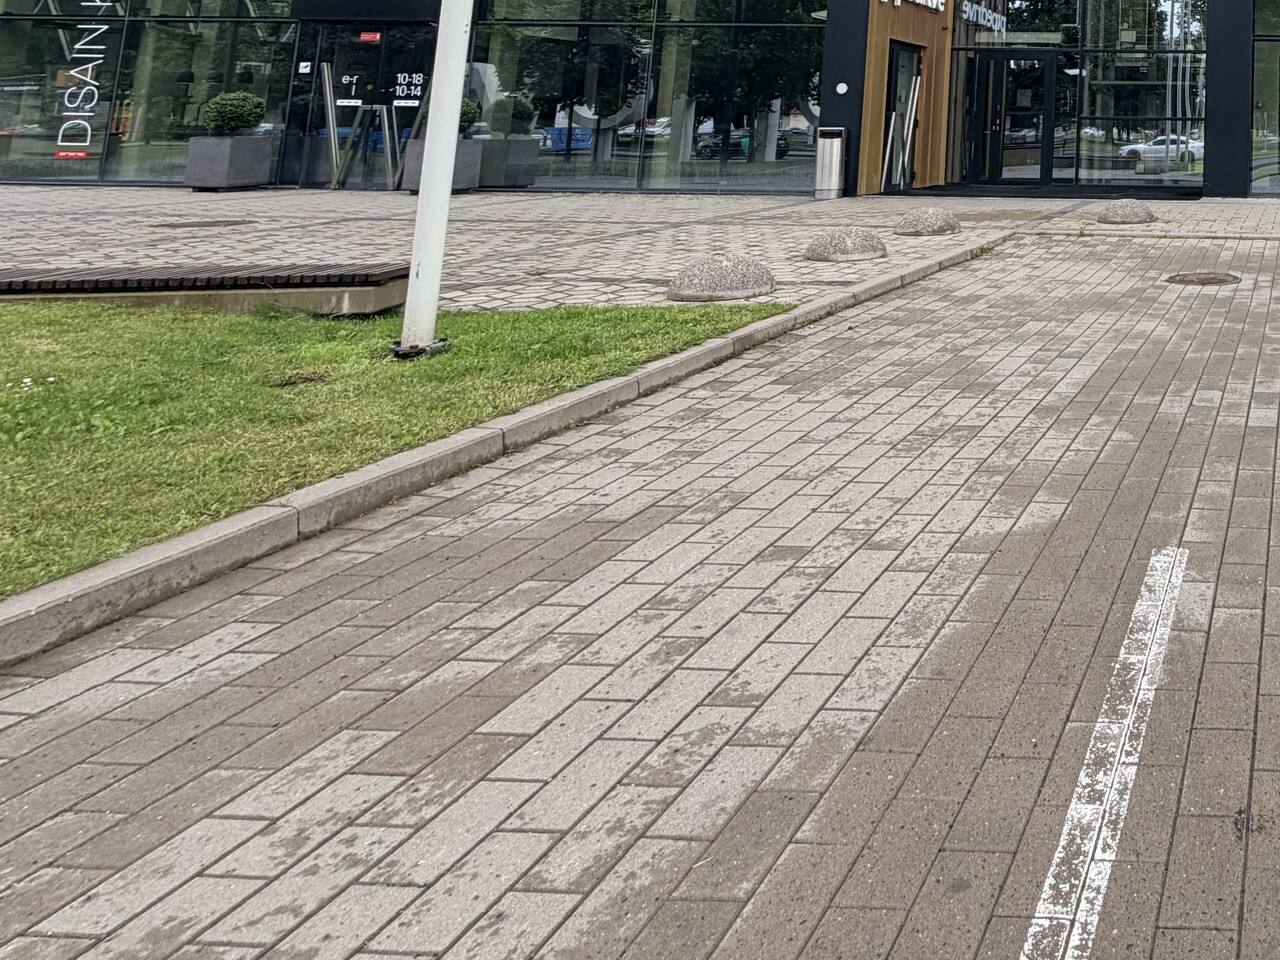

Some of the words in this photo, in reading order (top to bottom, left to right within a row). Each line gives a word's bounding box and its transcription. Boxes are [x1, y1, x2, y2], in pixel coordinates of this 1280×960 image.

[57, 23, 110, 147] DISAIN
[396, 73, 424, 85] 10-18
[394, 85, 422, 97] 10-14
